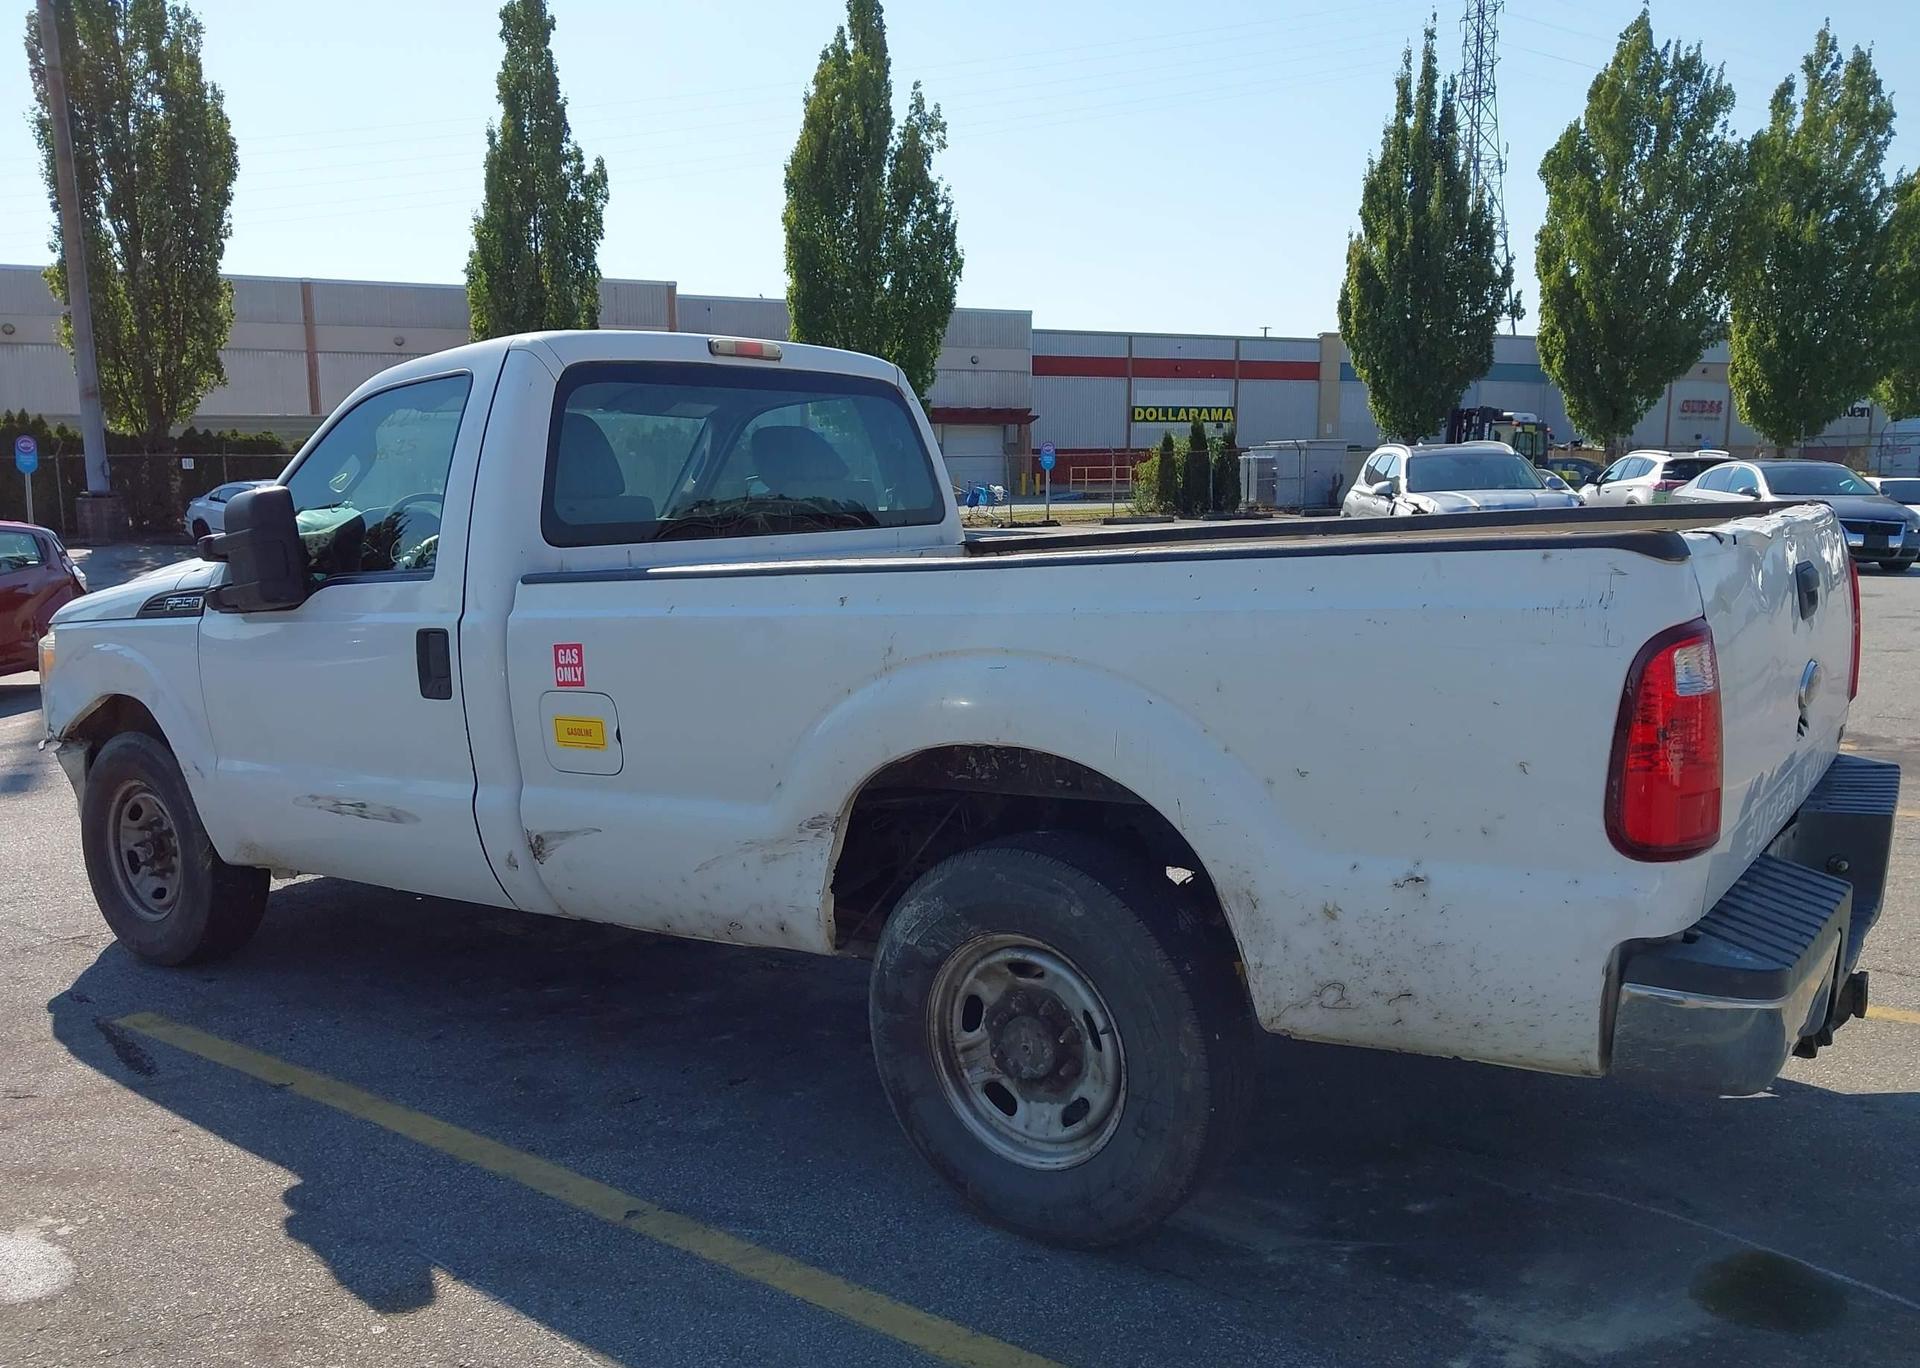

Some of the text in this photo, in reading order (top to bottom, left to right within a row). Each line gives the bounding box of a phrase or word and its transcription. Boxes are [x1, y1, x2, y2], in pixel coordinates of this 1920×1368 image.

[1134, 407, 1234, 421] DOLLARAMA
[558, 648, 579, 665] GAS
[556, 666, 583, 683] ONLY
[567, 727, 593, 738] GASOLINE
